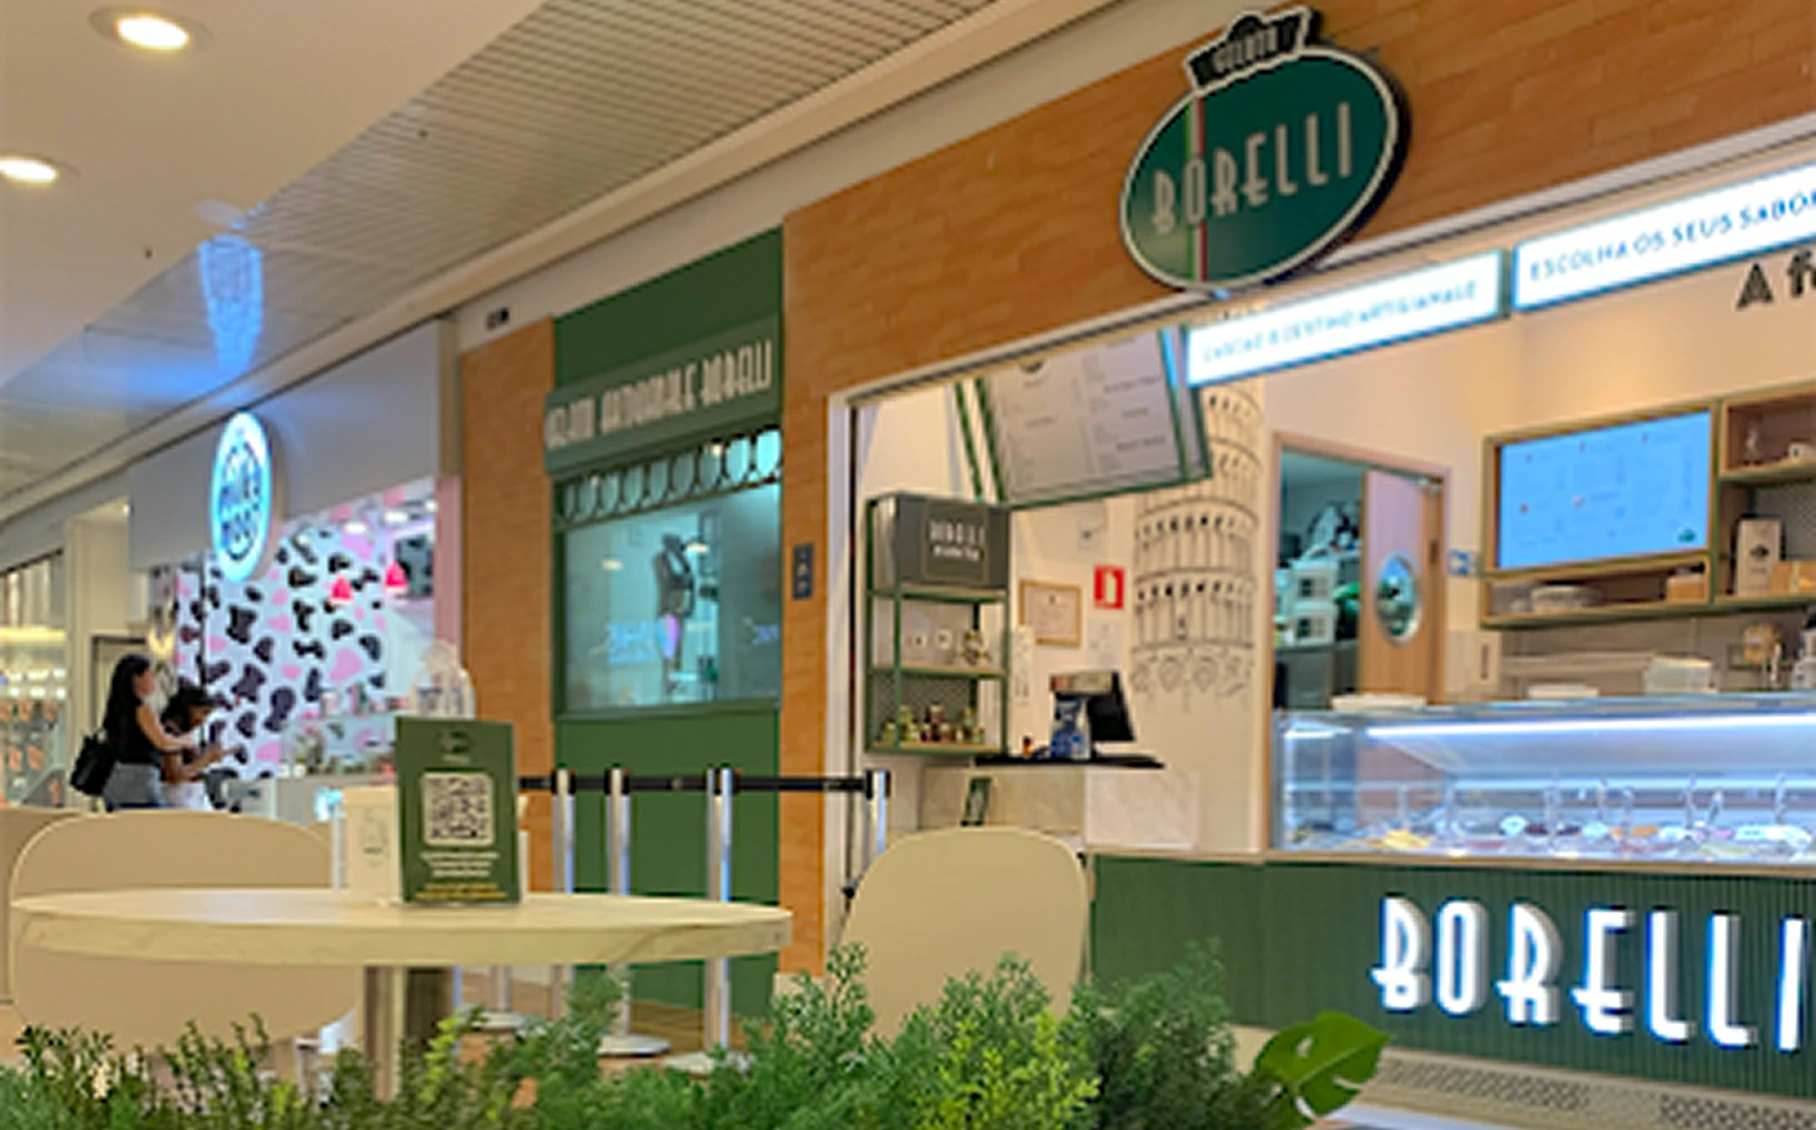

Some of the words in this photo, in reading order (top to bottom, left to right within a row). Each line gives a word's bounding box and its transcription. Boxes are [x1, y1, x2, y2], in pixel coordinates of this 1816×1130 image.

[1153, 101, 1351, 236] BORELLI
[1529, 240, 1629, 281] ESCOLHA
[1632, 229, 1666, 255] OS
[1671, 212, 1733, 247] SEUS
[1736, 261, 1774, 312] A
[1368, 895, 1808, 1054] BORELLI
